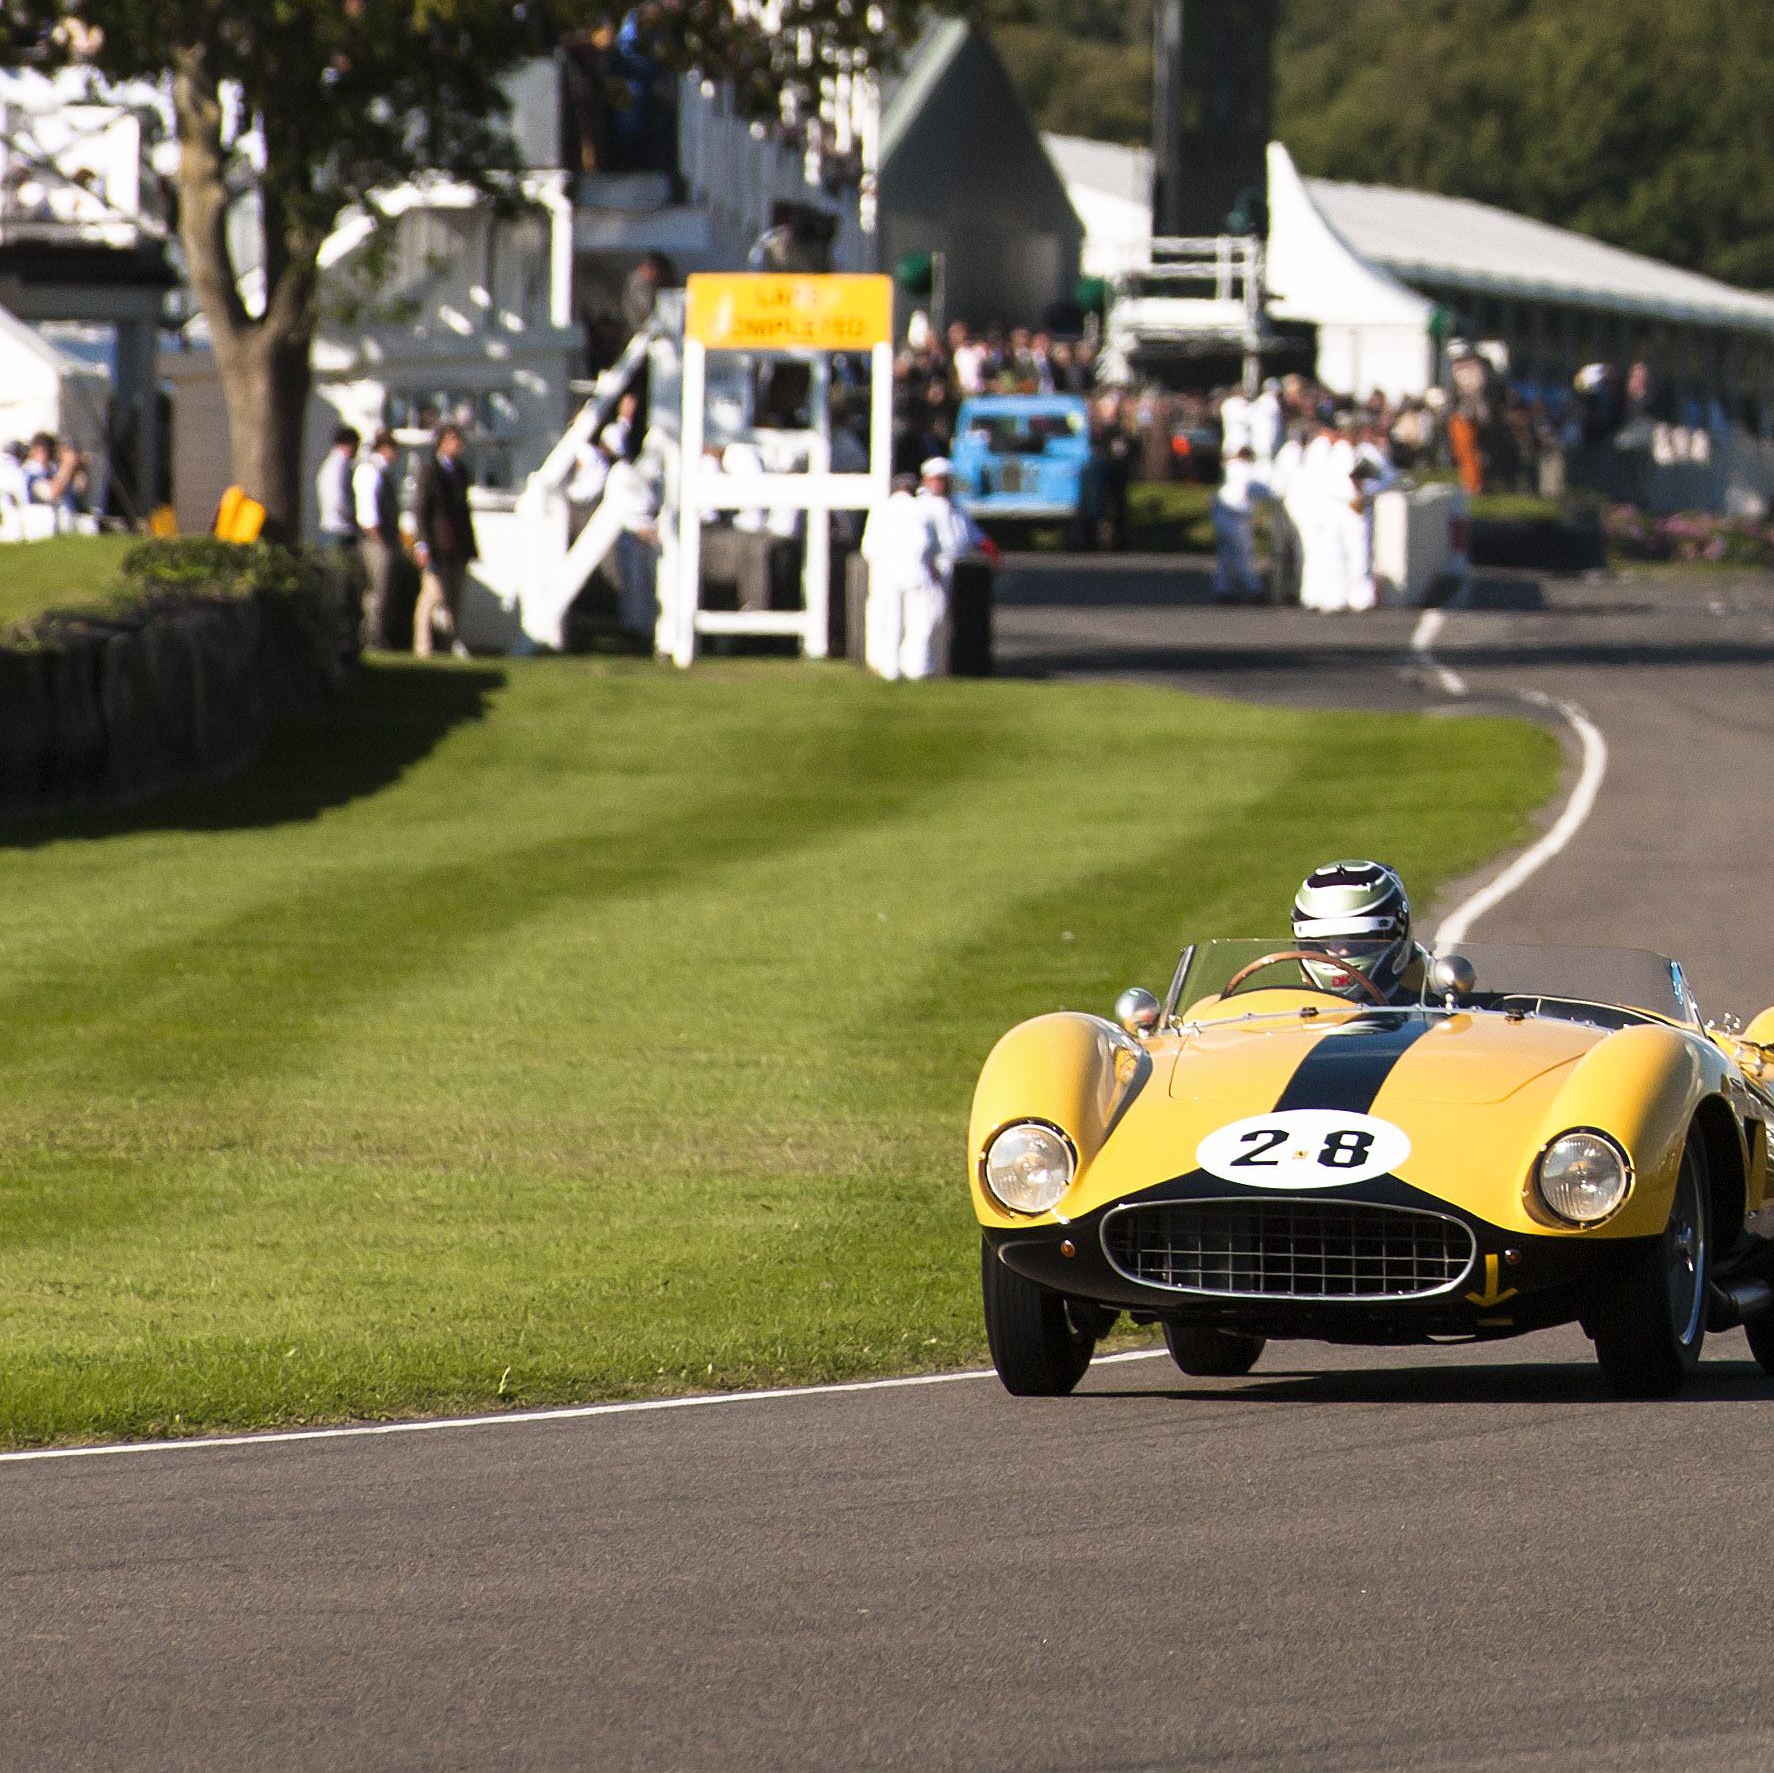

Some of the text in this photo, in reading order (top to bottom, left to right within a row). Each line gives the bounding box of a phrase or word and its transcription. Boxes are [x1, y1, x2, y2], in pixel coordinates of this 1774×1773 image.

[755, 287, 821, 308] LA
[712, 317, 868, 338] OMPLEED
[1229, 1129, 1375, 1169] 28
